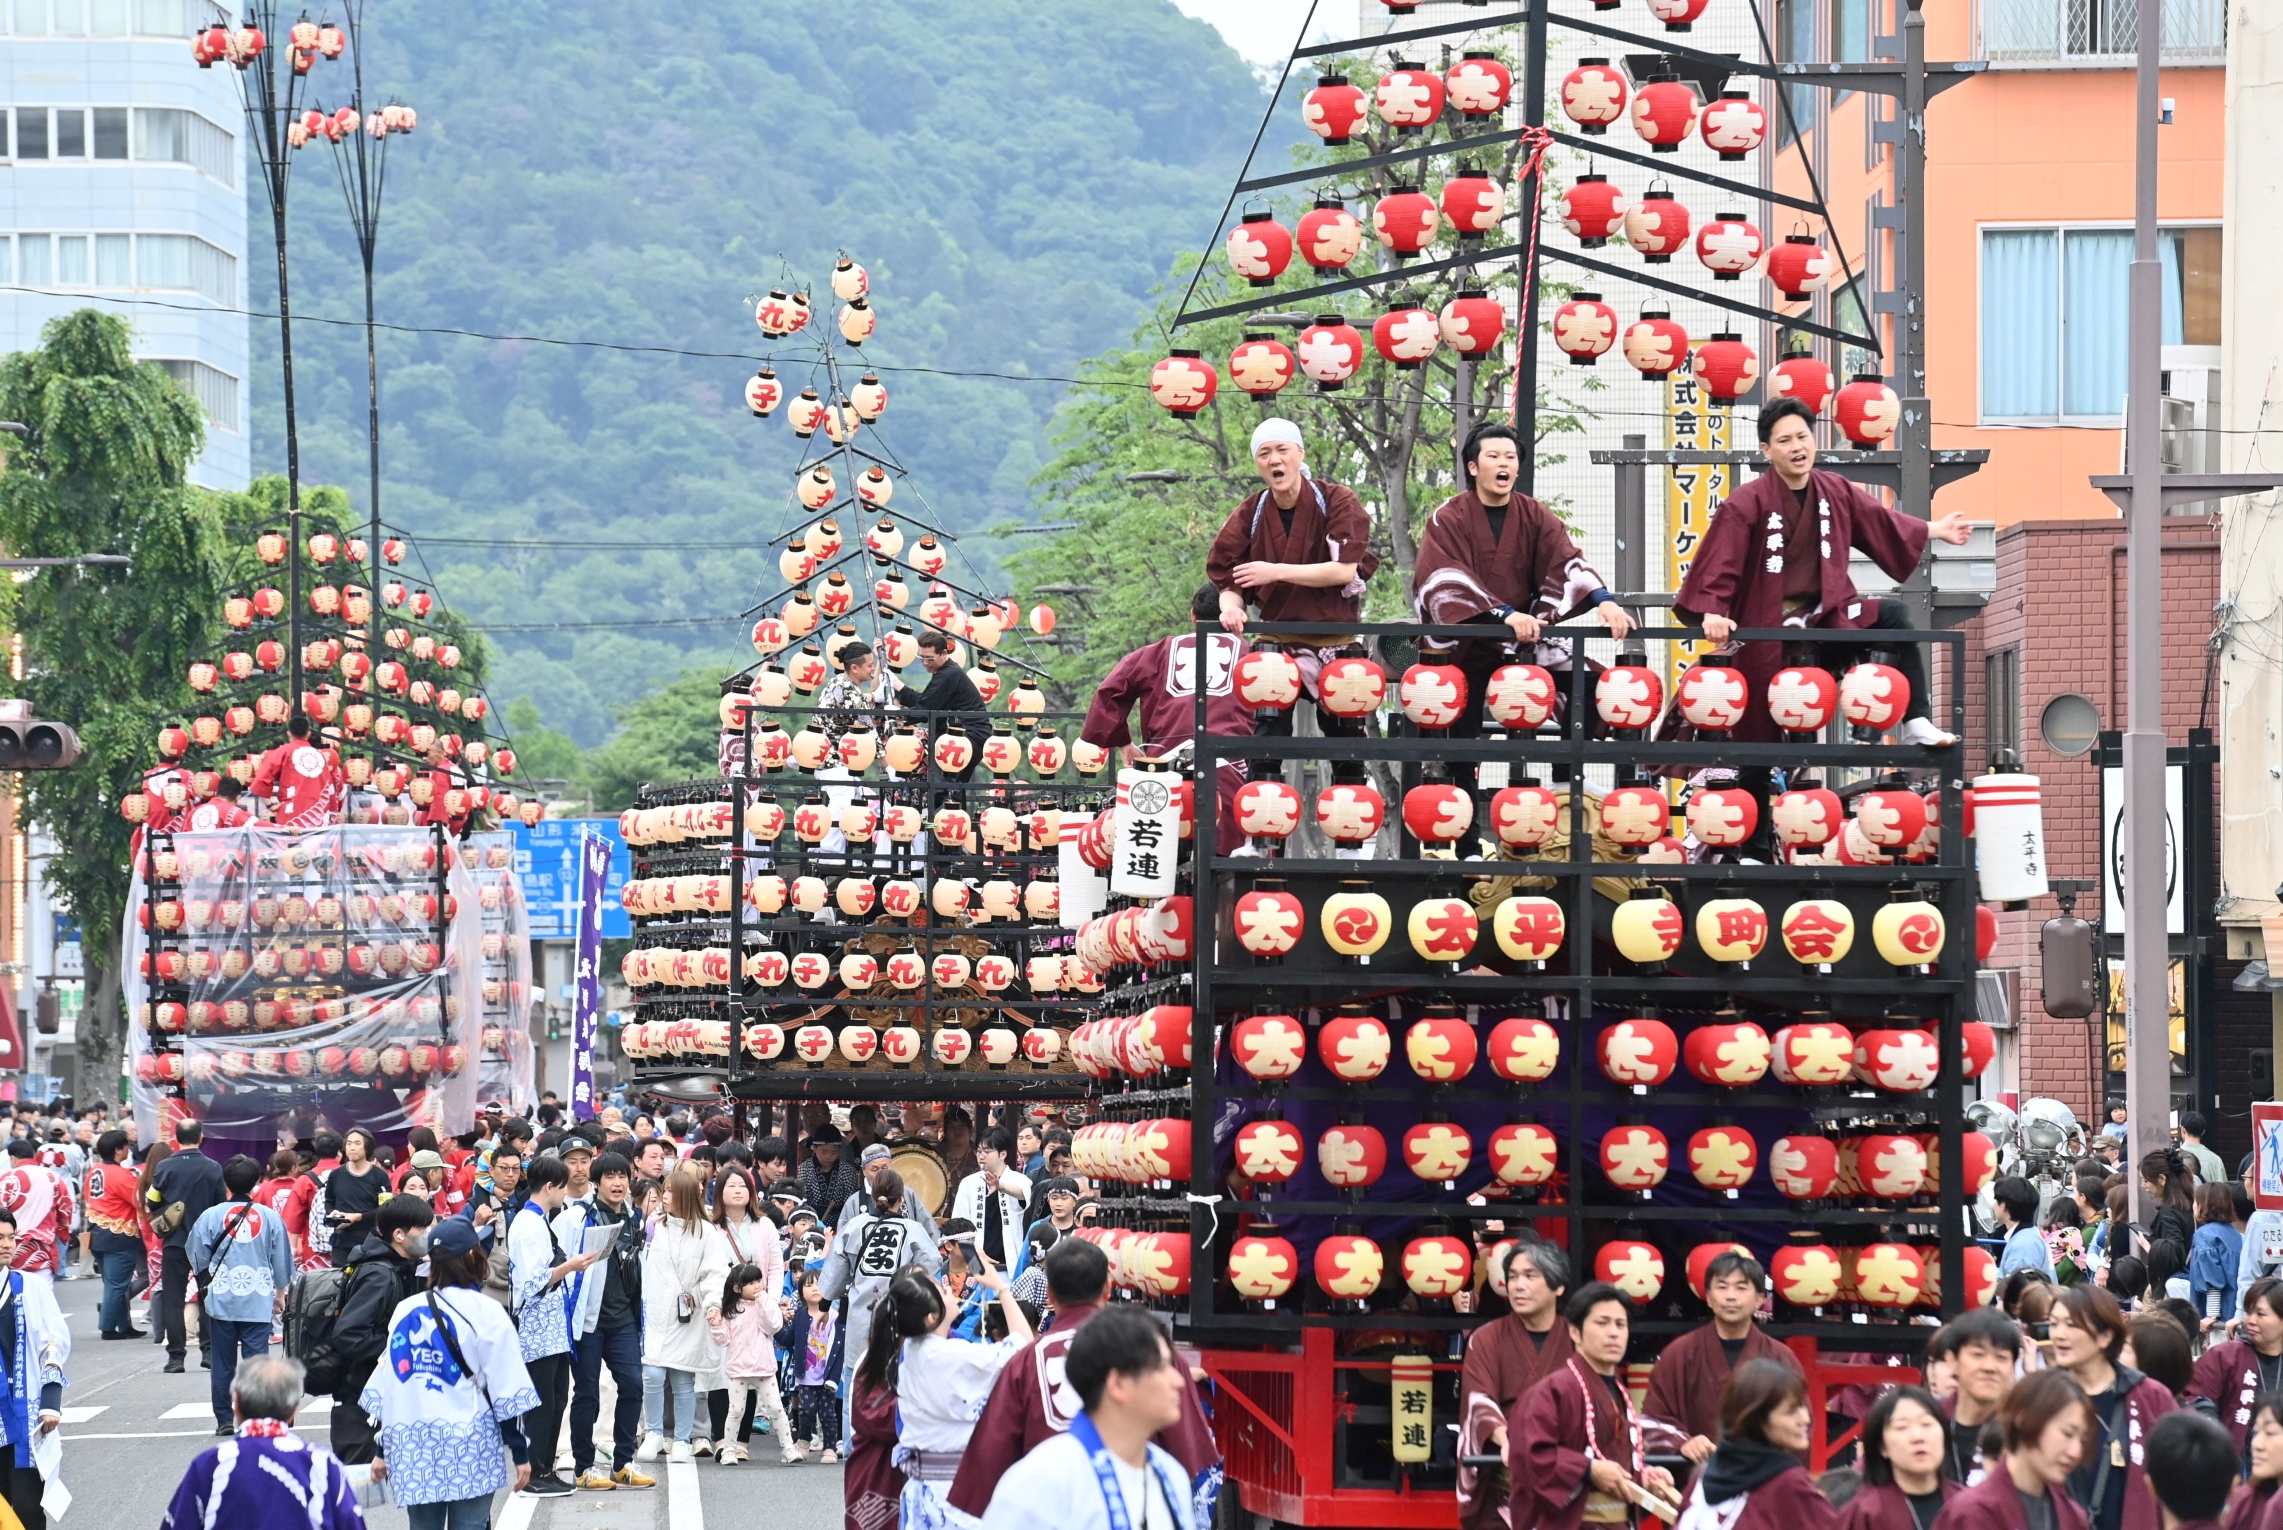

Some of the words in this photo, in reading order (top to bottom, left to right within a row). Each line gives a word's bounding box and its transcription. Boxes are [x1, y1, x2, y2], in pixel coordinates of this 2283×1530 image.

[1377, 74, 1431, 121] 太
[1447, 64, 1501, 111] 太
[1565, 70, 1621, 119] 太
[1707, 103, 1763, 152] 太
[1227, 229, 1270, 276] 太
[1314, 214, 1361, 264] 太
[1702, 223, 1759, 271] 太
[757, 302, 785, 331] 丸
[1390, 312, 1438, 358] 太
[1557, 300, 1611, 354] 太
[1232, 345, 1287, 393] 太
[1301, 332, 1353, 381] 太
[1623, 325, 1674, 370] 太
[751, 384, 777, 409] 子
[1152, 361, 1206, 411] 太
[1766, 512, 1784, 574] 太平寺
[1819, 499, 1832, 559] 太平寺
[820, 590, 849, 613] 丸
[930, 603, 955, 629] 子
[755, 622, 782, 645] 丸
[799, 661, 825, 686] 丸
[1241, 652, 1299, 706] 太
[1324, 664, 1381, 713] 太
[1402, 671, 1456, 725] 太
[1488, 666, 1548, 727] 太
[1595, 670, 1652, 726] 太
[1683, 670, 1744, 727] 太
[1841, 663, 1892, 724] 太
[1768, 672, 1823, 728] 太
[762, 735, 791, 760] 丸
[936, 740, 964, 768] 丸
[985, 743, 1007, 768] 子
[1030, 741, 1058, 768] 丸
[530, 823, 562, 837] 山形
[796, 809, 821, 836] 丸
[937, 814, 967, 840] 丸
[1241, 784, 1299, 835] 太
[1318, 788, 1374, 840] 太
[1500, 791, 1556, 844] 太
[1603, 792, 1660, 845] 太
[1687, 794, 1744, 846] 太
[1773, 794, 1826, 846] 太
[1127, 819, 1163, 880] 若連
[2023, 830, 2038, 877] 太平寺
[856, 884, 876, 911] 子
[883, 885, 911, 912] 丸
[1241, 899, 1298, 956] 太
[1510, 903, 1563, 955] 平
[1716, 908, 1768, 954] 町
[1783, 905, 1846, 958] 会
[756, 956, 786, 982] 丸
[795, 957, 821, 983] 子
[887, 959, 917, 983] 丸
[935, 958, 960, 982] 子
[977, 960, 1006, 985] 丸
[752, 1029, 777, 1054] 子
[800, 1030, 827, 1056] 子
[854, 1032, 876, 1057] 子
[882, 1031, 907, 1056] 丸
[939, 1034, 966, 1060] 子
[1023, 1032, 1046, 1058] 丸
[1244, 1021, 1303, 1079] 太
[1334, 1023, 1390, 1077] 太
[1407, 1022, 1455, 1078] 太
[1506, 1024, 1559, 1078] 太
[1607, 1024, 1657, 1081] 太
[1715, 1027, 1769, 1082] 太
[1791, 1027, 1853, 1081] 太
[1878, 1033, 1938, 1089] 太
[1239, 1125, 1297, 1176] 太
[1410, 1127, 1471, 1179] 太
[1495, 1128, 1556, 1185] 太
[1607, 1131, 1668, 1189] 太
[1691, 1132, 1754, 1188] 太
[1872, 1140, 1926, 1195] 太
[1230, 1243, 1290, 1298] 太
[1329, 1240, 1383, 1296] 太
[1405, 1242, 1464, 1298] 太
[1783, 1251, 1841, 1302] 太
[1856, 1246, 1920, 1306] 太
[14, 1307, 25, 1399] 福島商工会議所青年部
[411, 1347, 444, 1364] YEG
[1401, 1390, 1429, 1449] 若連
[2235, 1369, 2257, 1425] 太平寺
